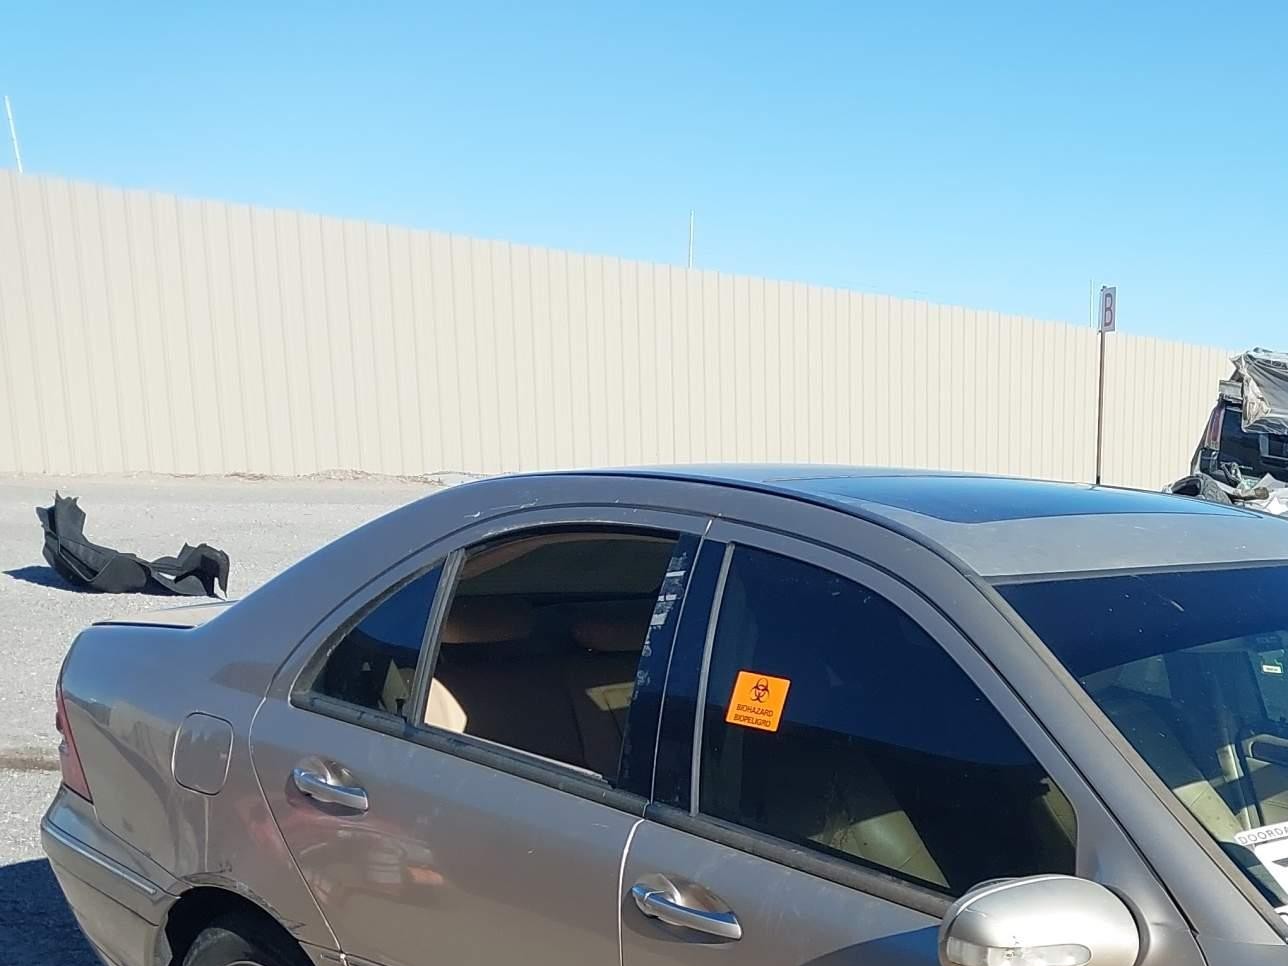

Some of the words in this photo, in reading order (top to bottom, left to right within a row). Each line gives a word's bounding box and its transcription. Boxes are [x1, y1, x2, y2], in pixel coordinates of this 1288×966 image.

[1103, 292, 1113, 328] B
[735, 703, 774, 718] BIOHAZARD
[733, 713, 771, 727] BIOPELIGRO
